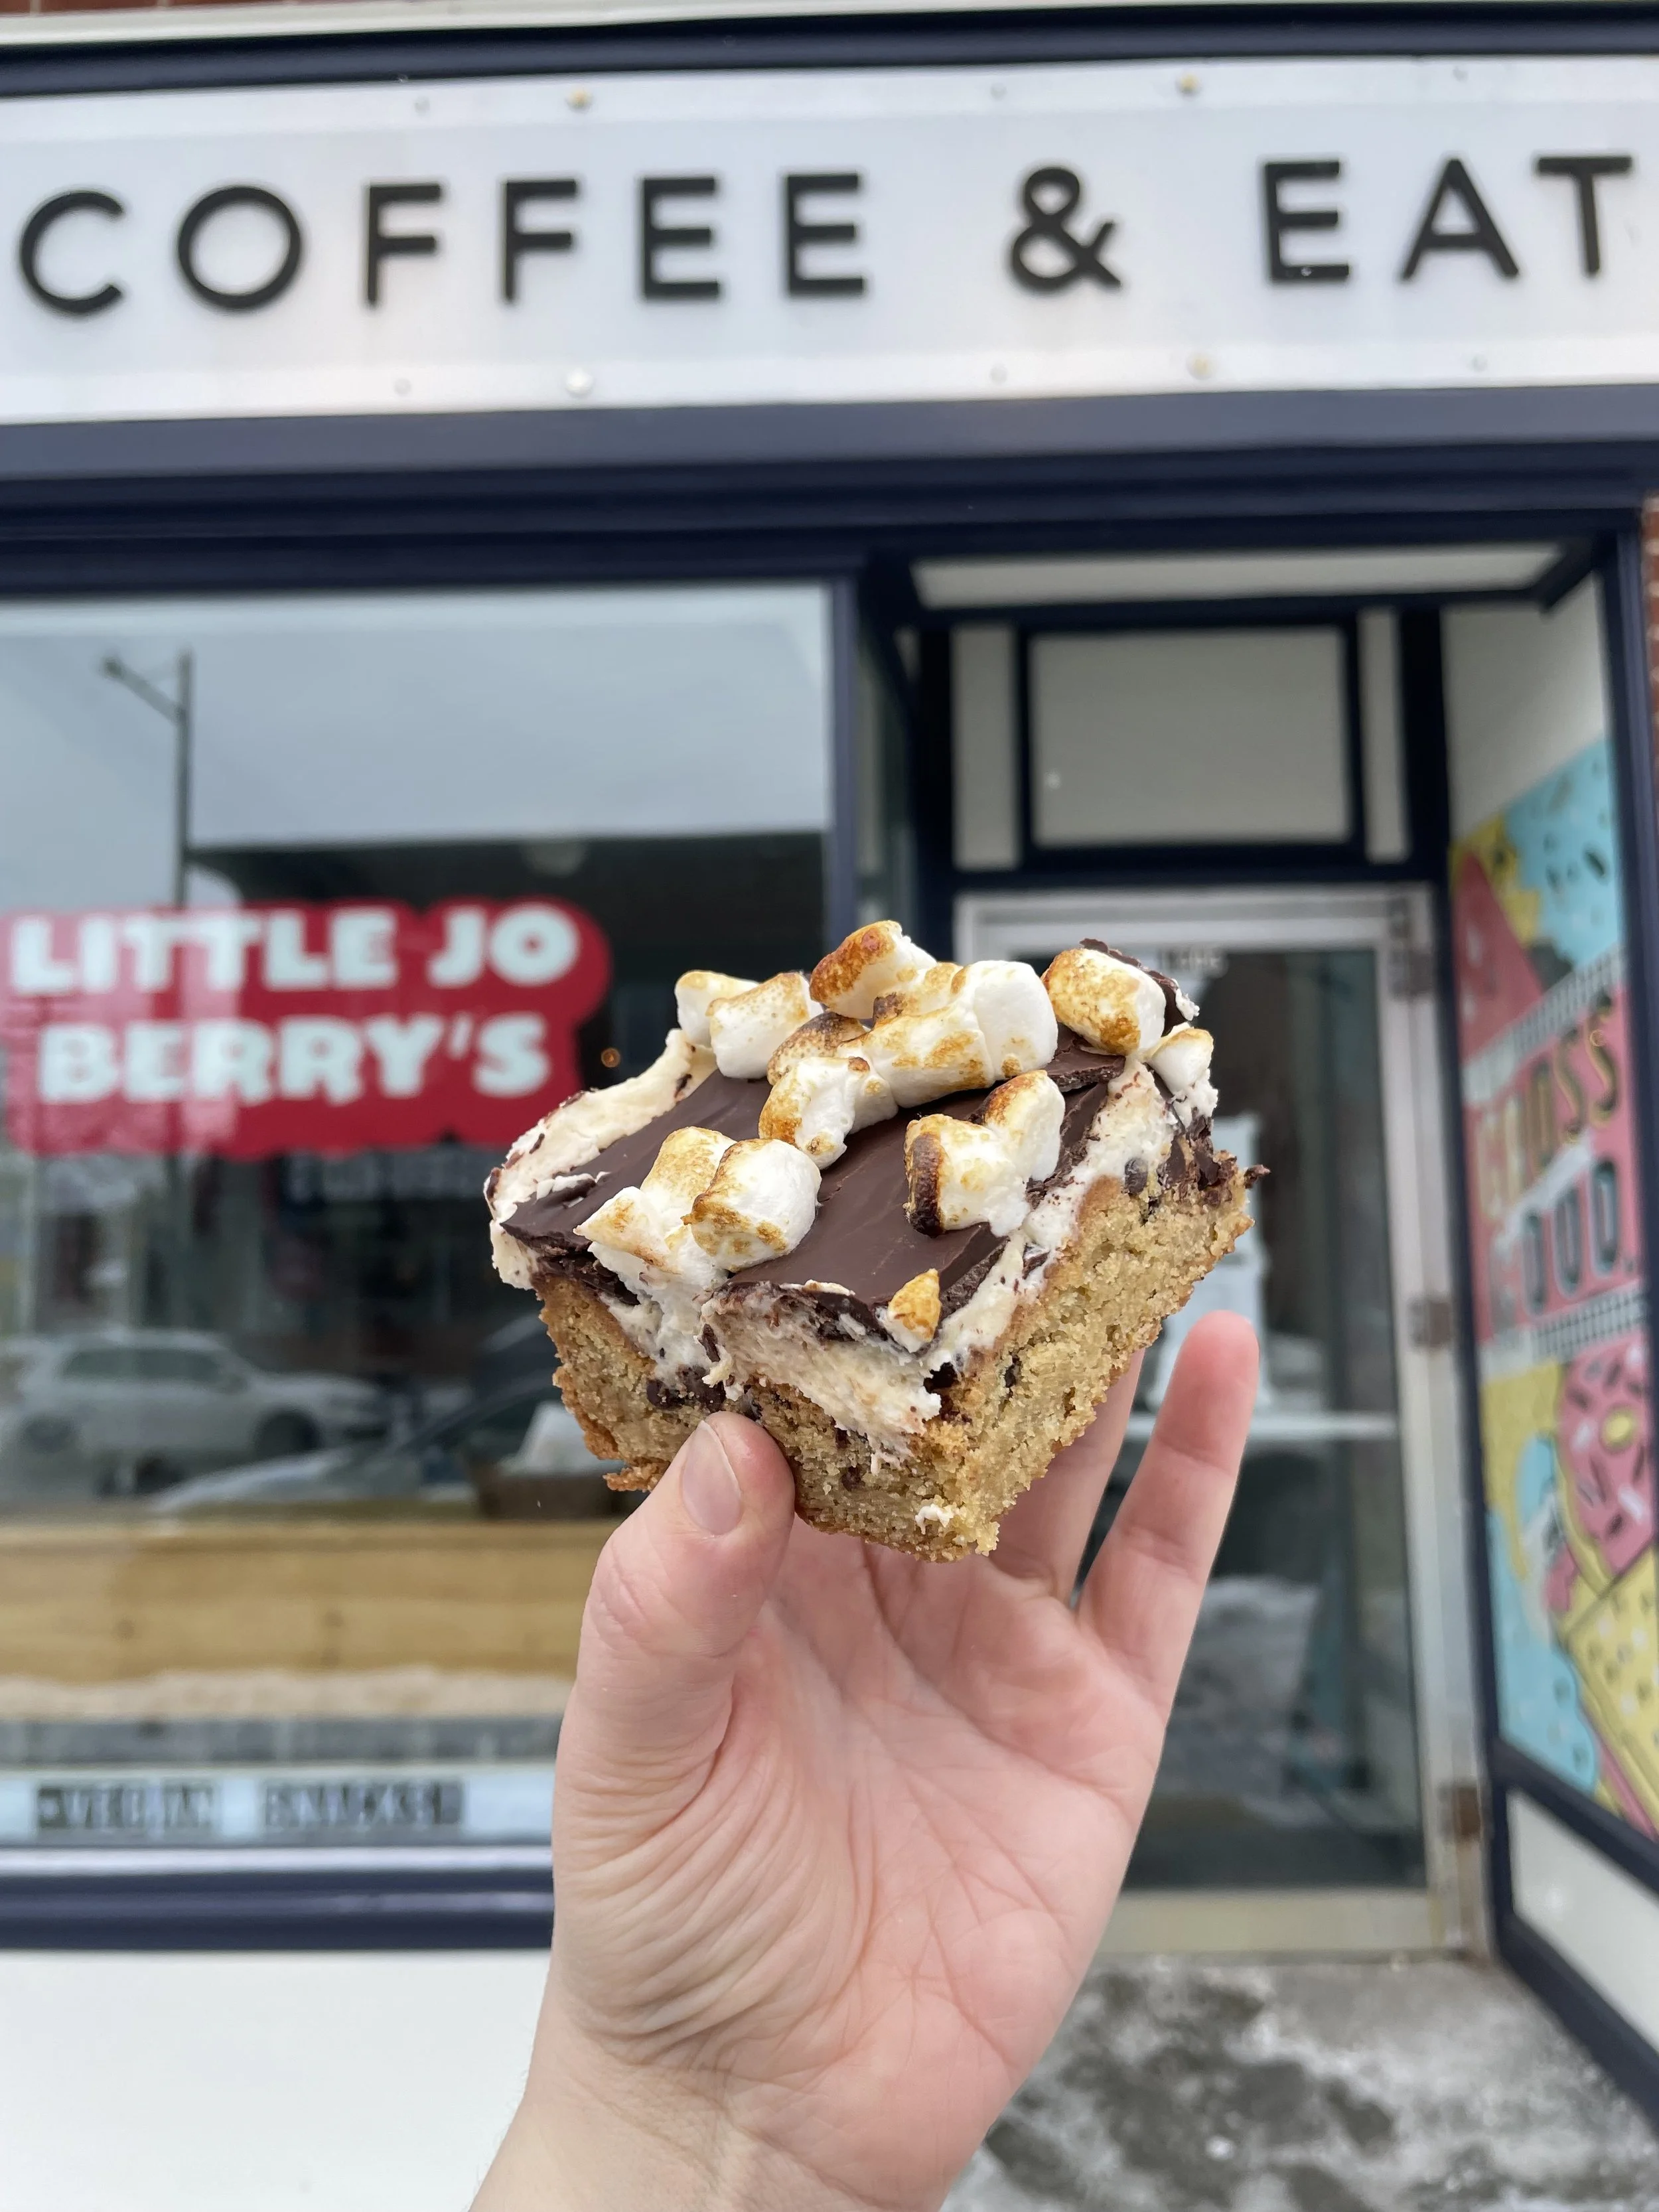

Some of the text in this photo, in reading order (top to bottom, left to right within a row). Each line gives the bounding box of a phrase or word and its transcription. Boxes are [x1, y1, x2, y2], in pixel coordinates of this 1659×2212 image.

[19, 155, 1632, 315] COFFEE & EAT
[10, 901, 581, 995] LITTLE JO
[37, 1011, 551, 1106] BERRY'S
